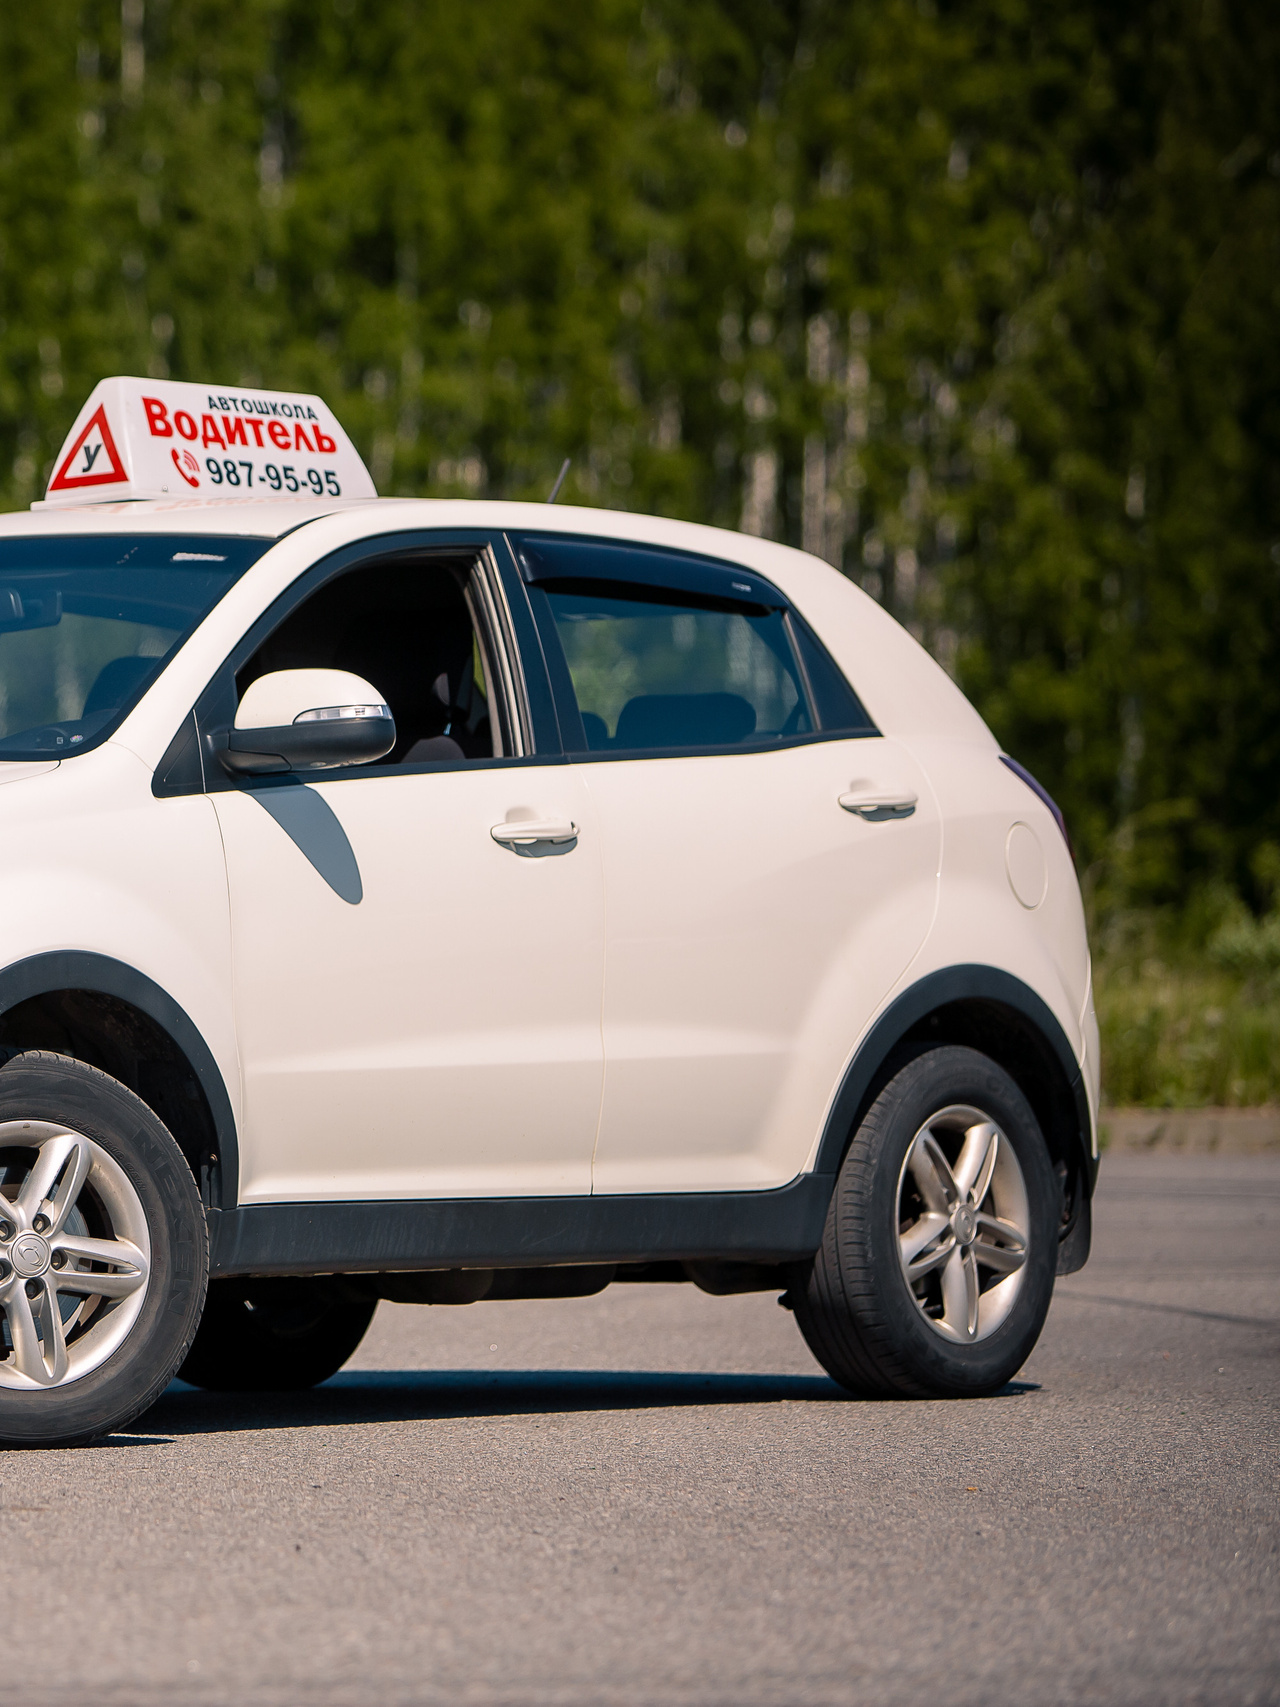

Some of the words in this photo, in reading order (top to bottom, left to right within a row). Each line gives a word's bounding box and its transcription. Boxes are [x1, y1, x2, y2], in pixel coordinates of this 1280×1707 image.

[142, 395, 338, 454] Водитель
[208, 395, 318, 421] АВТОШКОЛА
[81, 443, 103, 473] У
[206, 457, 342, 498] 987-95-95
[132, 1127, 193, 1317] NEXEN
